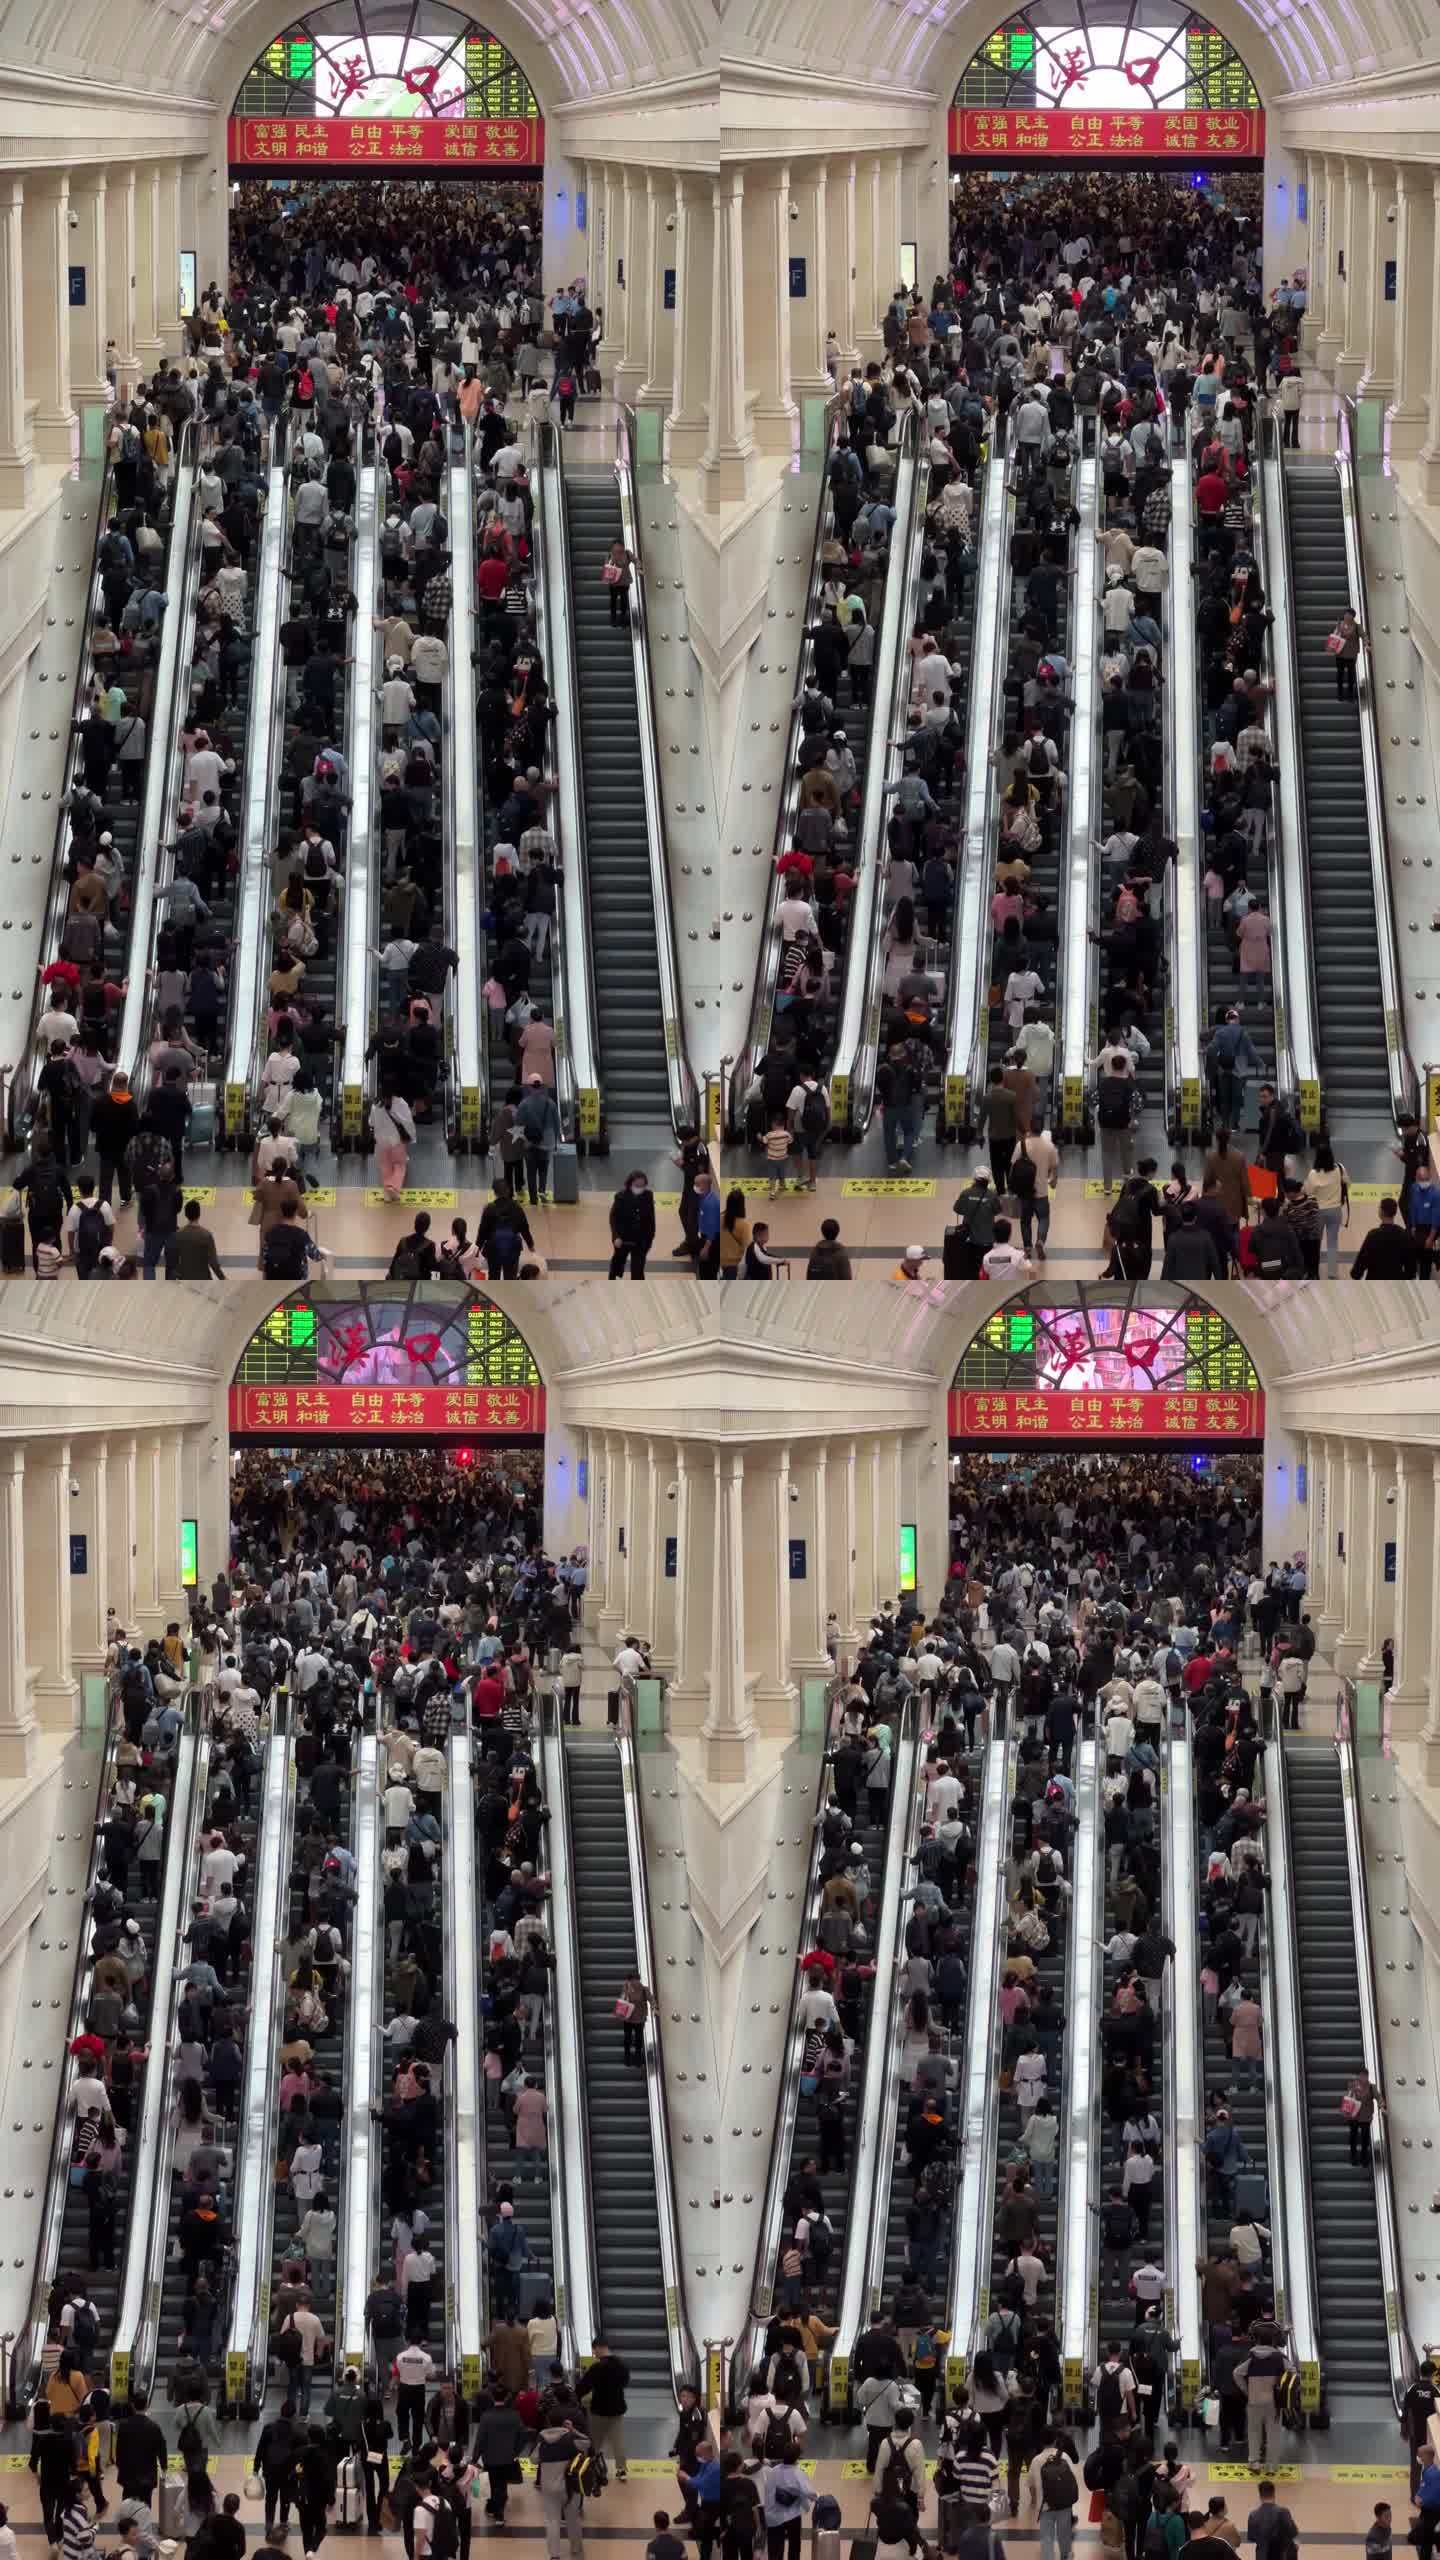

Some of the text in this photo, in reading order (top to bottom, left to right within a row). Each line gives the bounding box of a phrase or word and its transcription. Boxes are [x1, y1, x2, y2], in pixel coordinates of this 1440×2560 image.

[1049, 45, 1160, 91] 漢口
[329, 54, 440, 99] 漢口
[974, 115, 1240, 130] 富强 民主 自由 平等 爱国 敬业
[255, 124, 519, 139] 富强 民主 自由 平等 爱国 敬业
[973, 133, 1240, 147] 文明 和谐 公正 法治 诚信 友善
[254, 142, 519, 157] 文明 和谐 公正 法治 诚信 友善
[329, 1322, 441, 1368] 漢口
[1049, 1327, 1160, 1372] 漢口
[255, 1392, 521, 1407] 富强 民主 自由 平等 爱国 敬业
[974, 1397, 1240, 1412] 富强 民主 自由 平等 爱国 敬业
[255, 1410, 520, 1424] 文明 和谐 公正 法治 诚信 友善
[973, 1415, 1240, 1429] 文明 和谐 公正 法治 诚信 友善
